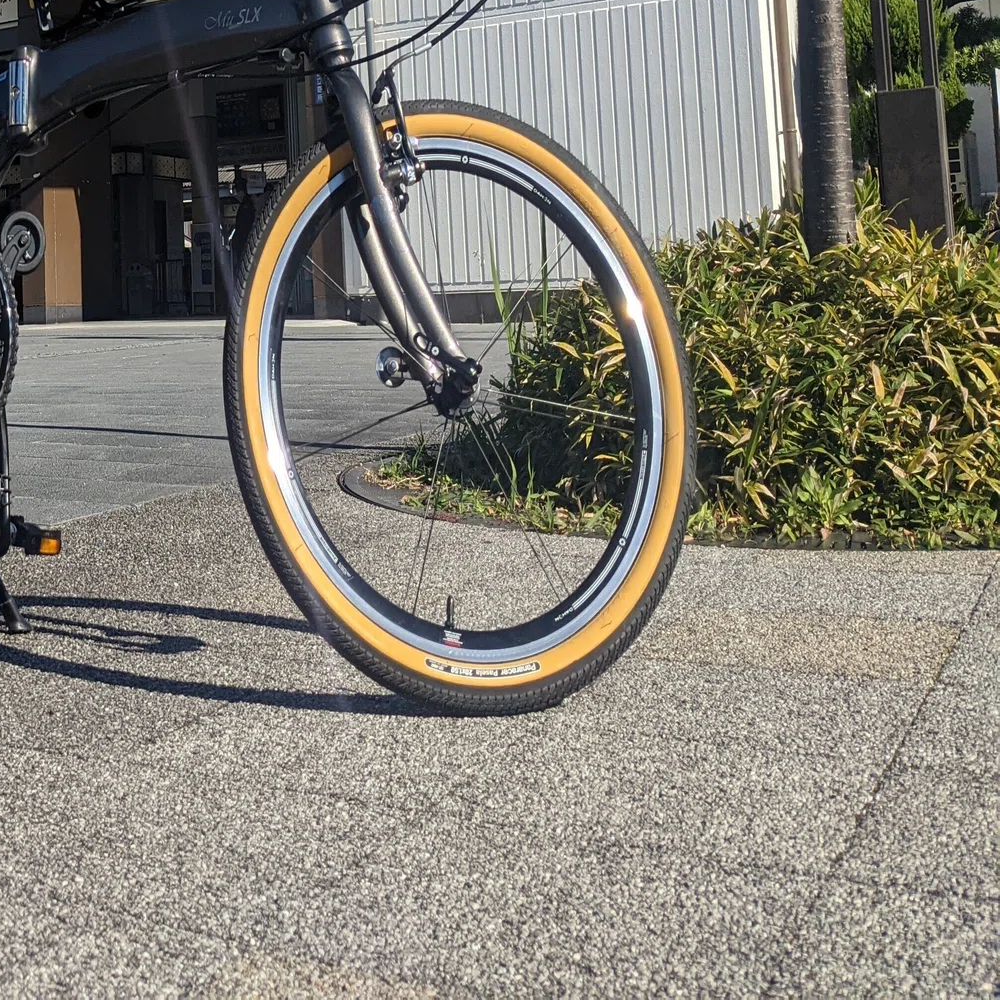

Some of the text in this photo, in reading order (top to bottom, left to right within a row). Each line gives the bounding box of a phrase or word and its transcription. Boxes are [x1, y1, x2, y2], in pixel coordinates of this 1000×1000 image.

[205, 6, 263, 30] Mu SLX
[475, 668, 499, 677] Pasela
[501, 662, 537, 676] Panaracer
